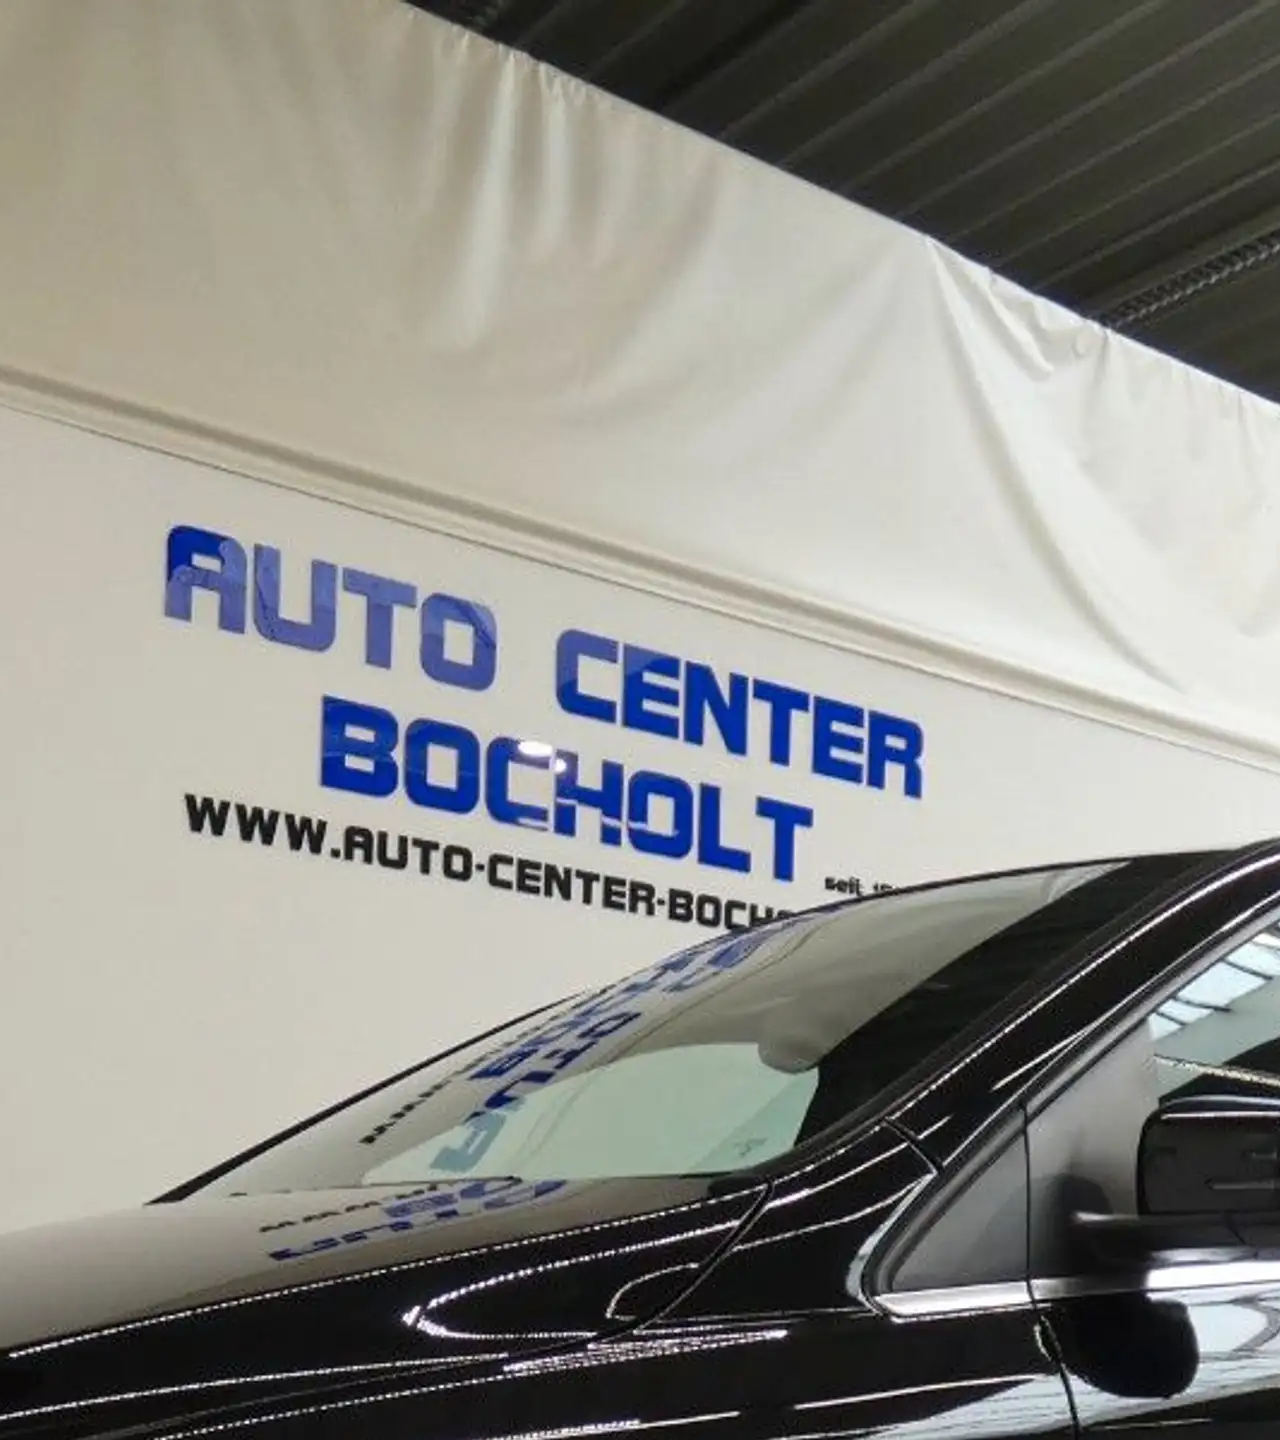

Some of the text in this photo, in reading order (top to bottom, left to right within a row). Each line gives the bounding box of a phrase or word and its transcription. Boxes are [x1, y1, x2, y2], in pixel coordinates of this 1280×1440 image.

[164, 525, 923, 799] AUTO CENTER
[321, 695, 814, 882] BOCHOLT
